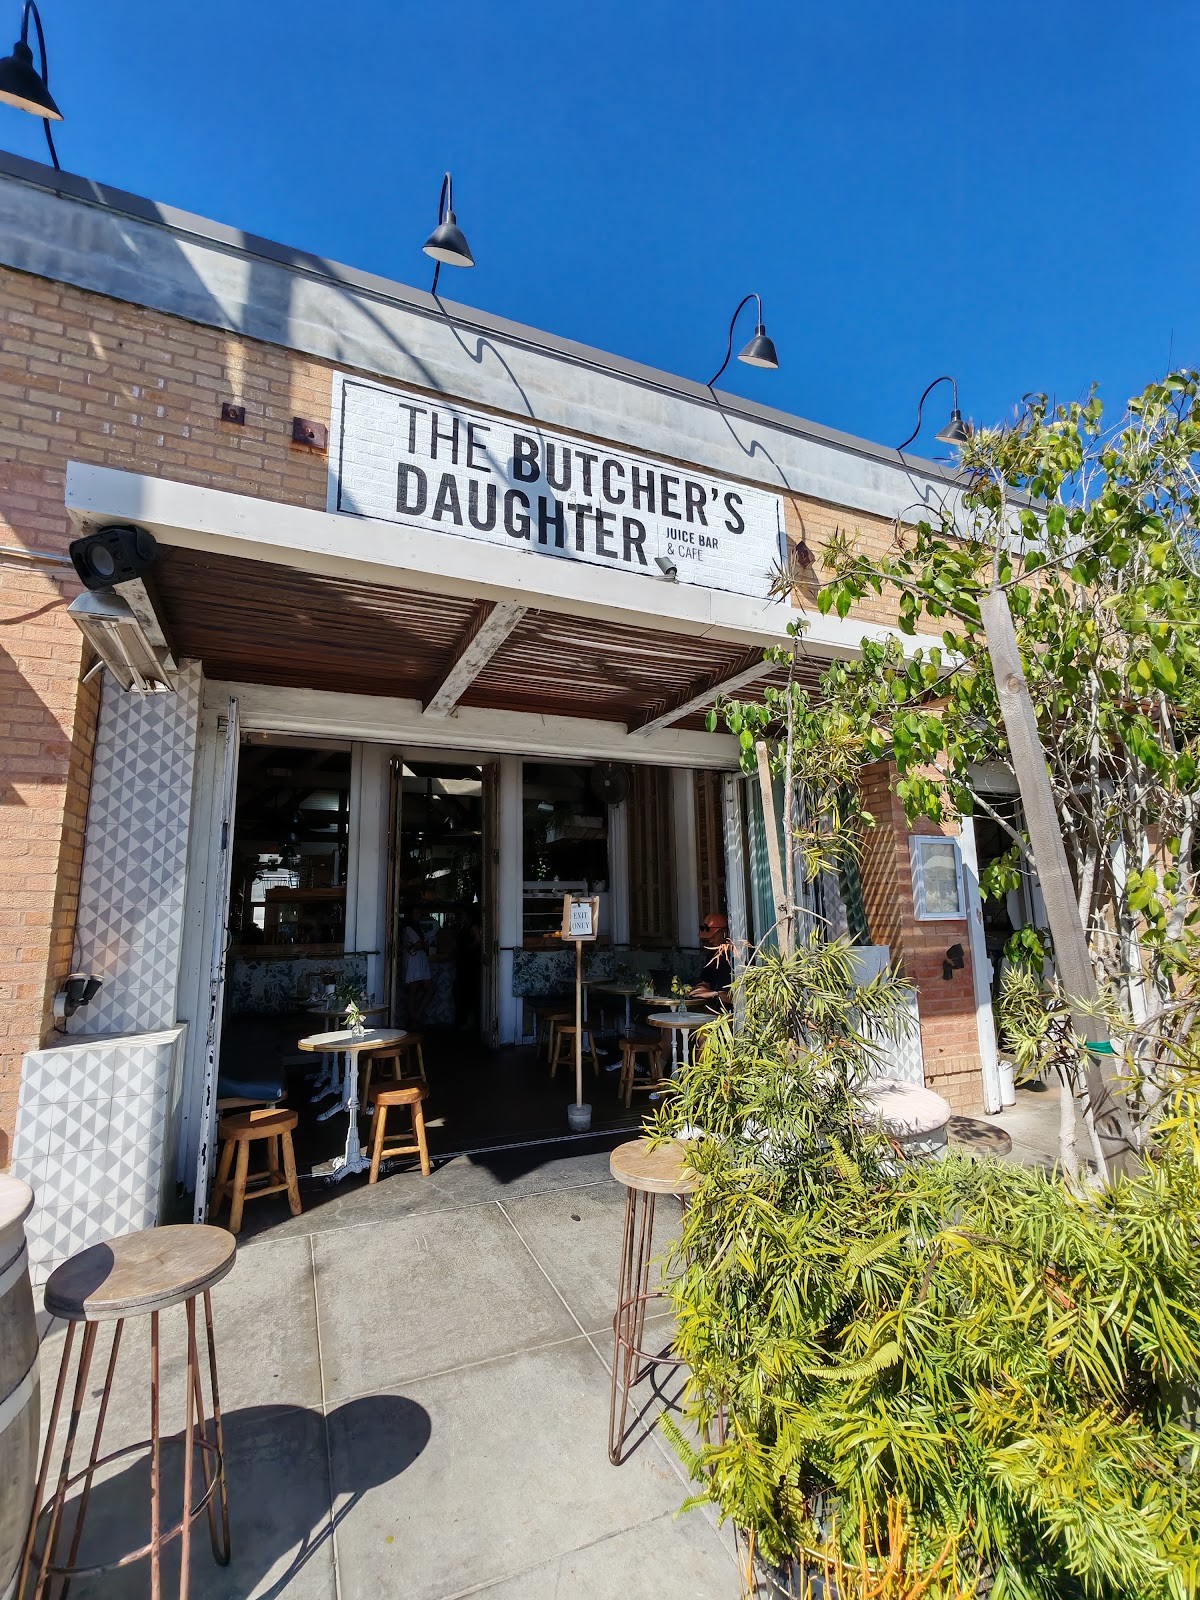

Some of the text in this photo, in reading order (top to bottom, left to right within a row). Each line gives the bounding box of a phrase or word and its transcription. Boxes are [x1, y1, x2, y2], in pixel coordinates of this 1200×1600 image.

[399, 403, 745, 535] THE BUTCHER'S
[396, 461, 647, 566] DAUGHTER
[666, 527, 719, 550] JUICE BAR
[667, 542, 675, 555] &
